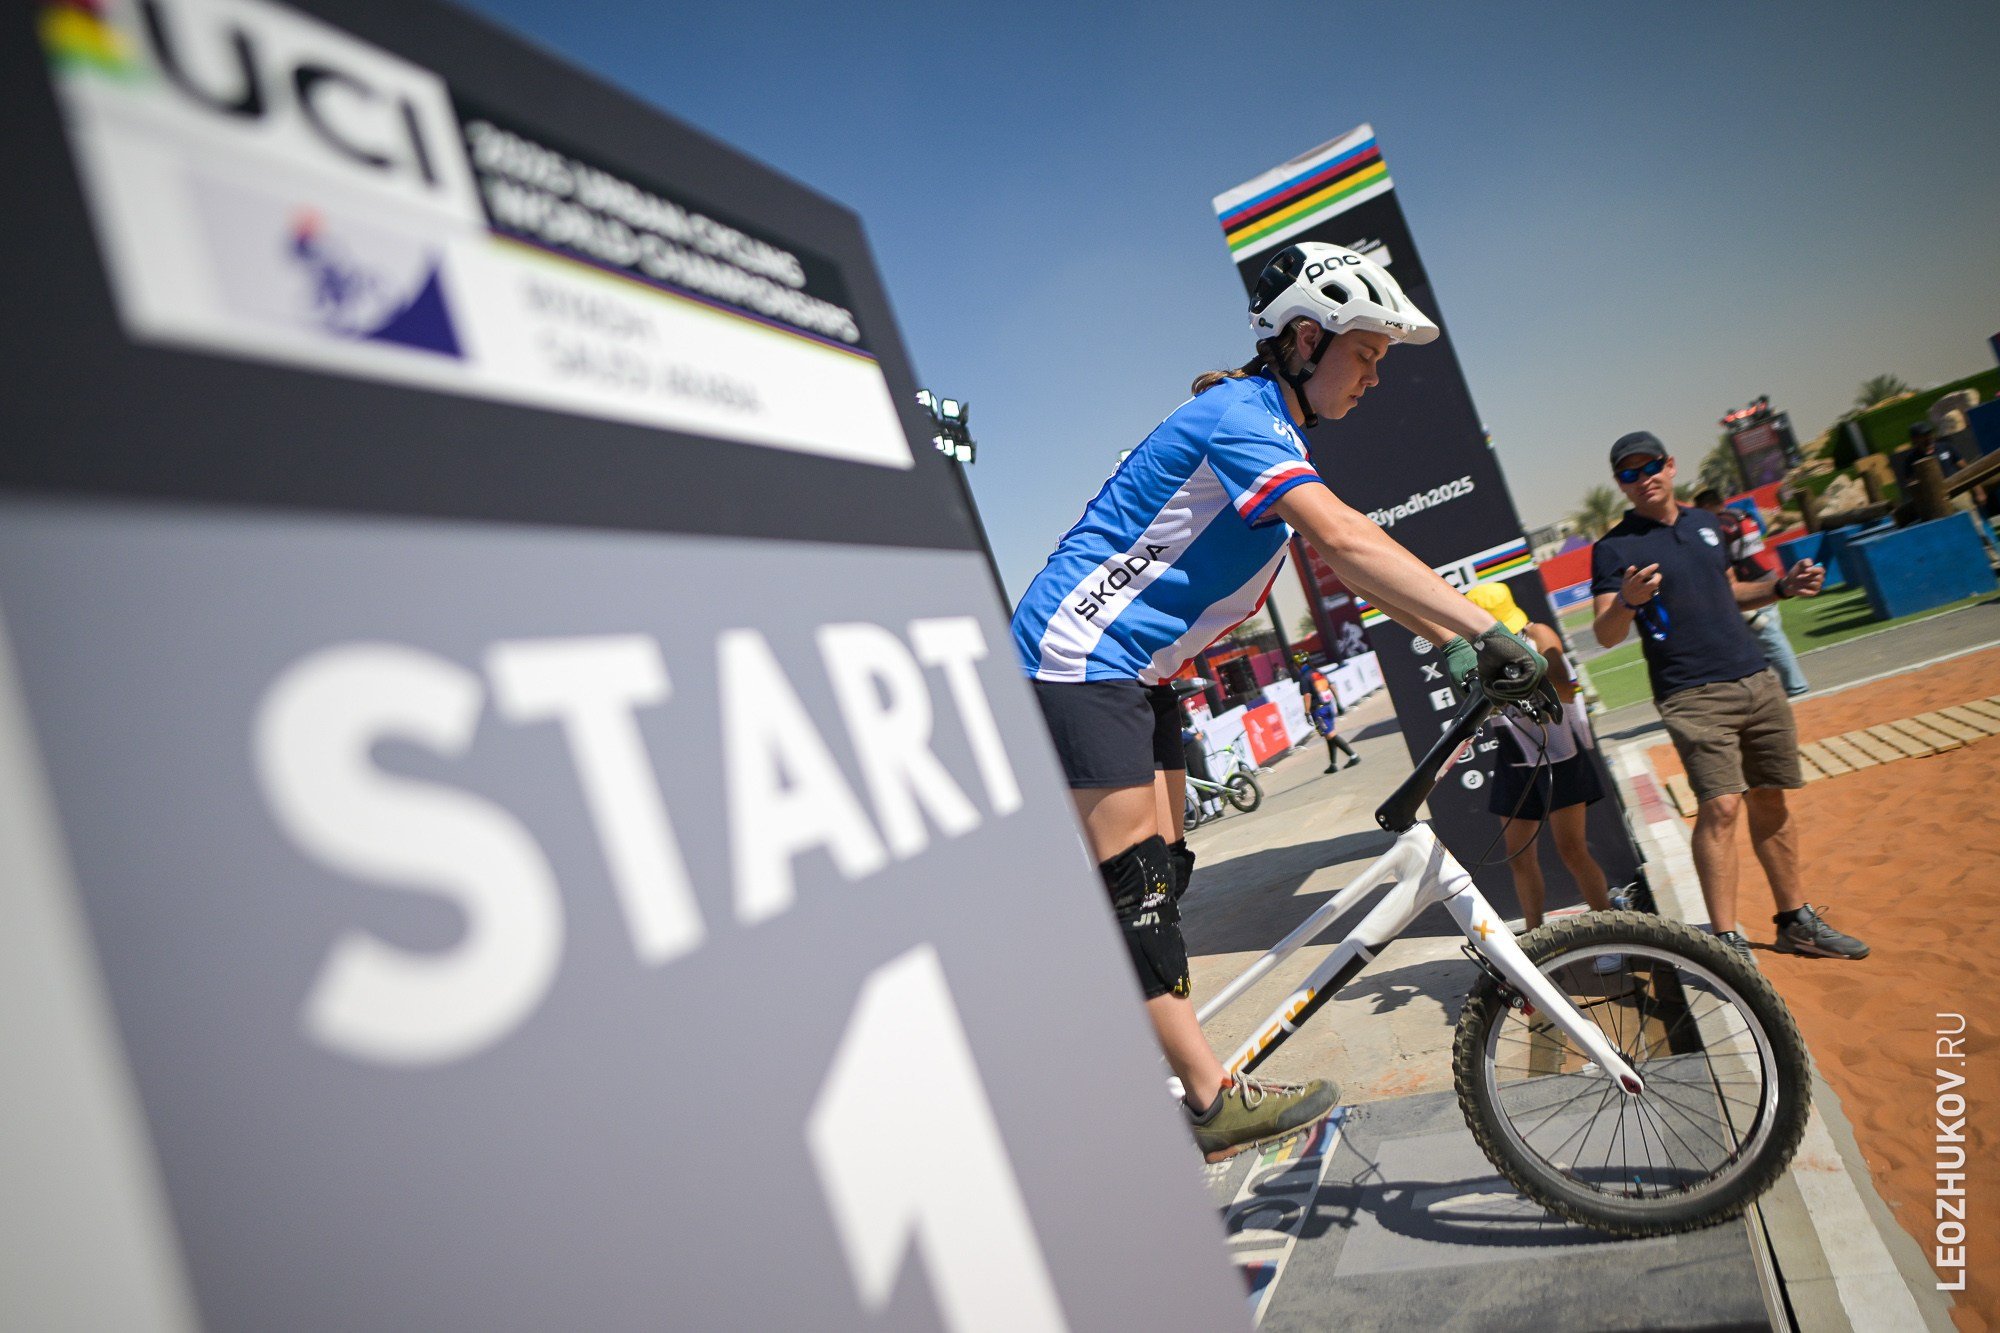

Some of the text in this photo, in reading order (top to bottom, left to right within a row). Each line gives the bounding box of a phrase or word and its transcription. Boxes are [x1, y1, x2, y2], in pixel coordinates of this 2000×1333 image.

[133, 0, 442, 188] UCI
[254, 618, 1023, 1067] START
[807, 943, 1072, 1333] 1
